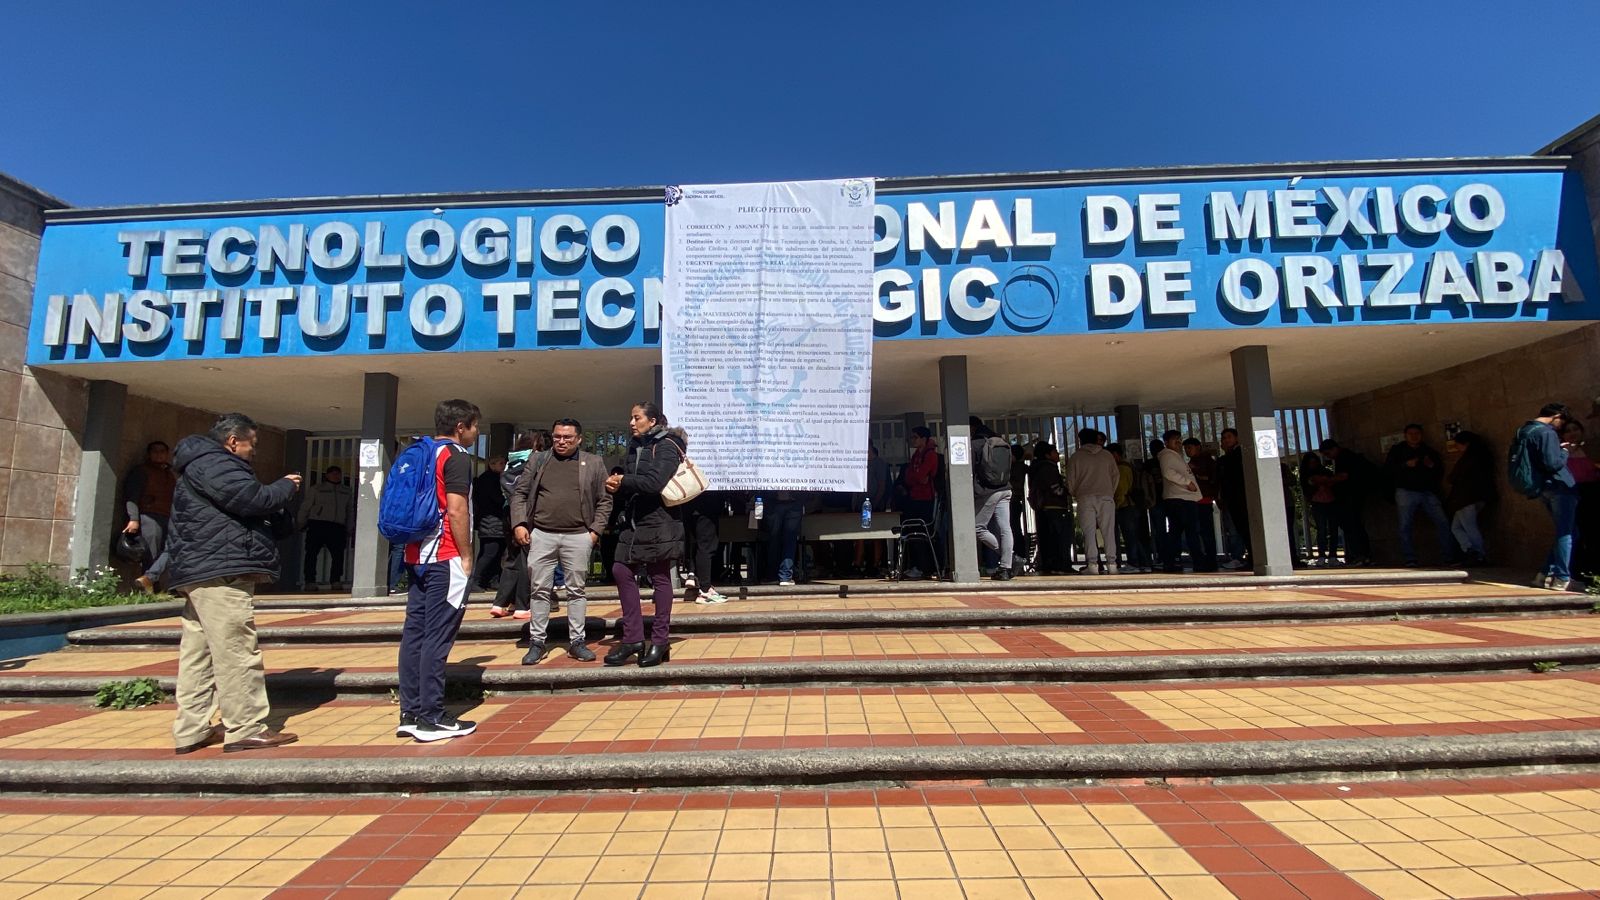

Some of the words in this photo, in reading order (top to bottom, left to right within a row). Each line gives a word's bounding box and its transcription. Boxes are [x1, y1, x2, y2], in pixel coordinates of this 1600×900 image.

[769, 206, 811, 214] PETITORIO
[1085, 193, 1185, 245] DE
[1208, 176, 1506, 241] MÉXICO
[44, 284, 464, 346] INSTITUTO
[1090, 261, 1197, 316] DE
[1221, 250, 1585, 314] ORIZABA
